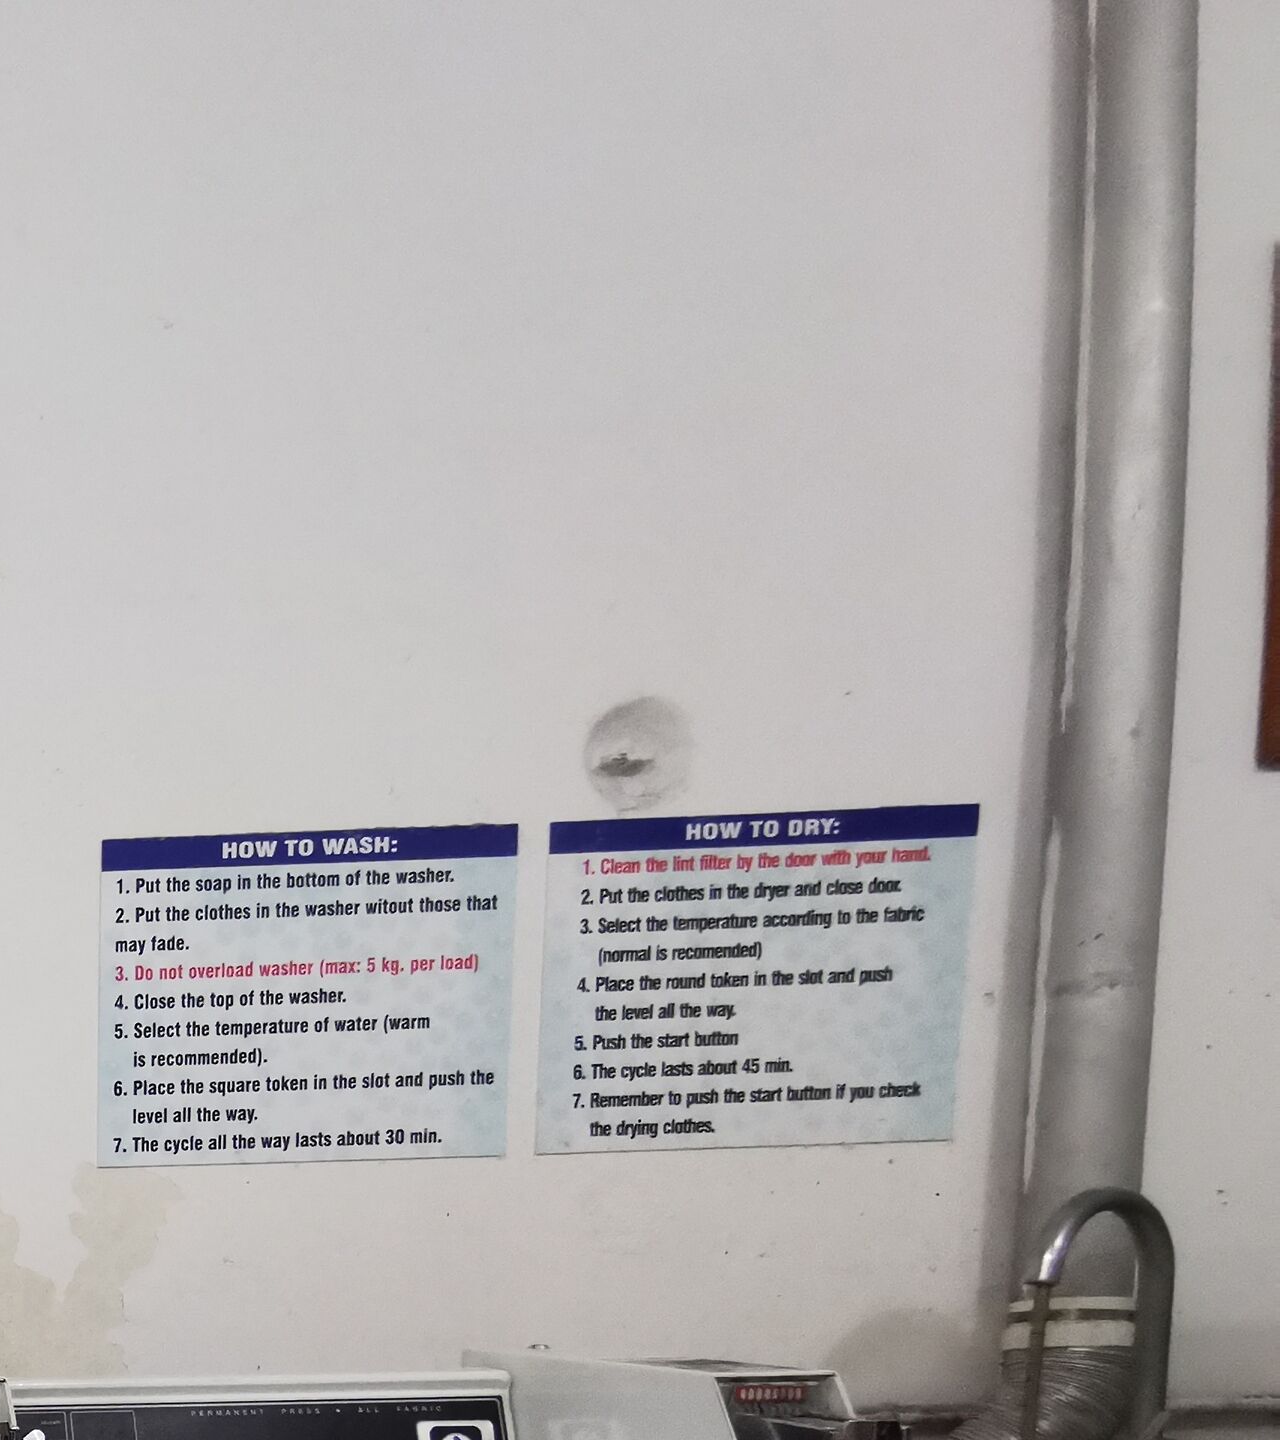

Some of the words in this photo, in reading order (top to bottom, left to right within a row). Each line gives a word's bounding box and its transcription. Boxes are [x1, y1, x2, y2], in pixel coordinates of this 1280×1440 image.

[686, 822, 742, 840] HOW
[751, 820, 778, 838] TO
[788, 818, 839, 836] DRY:
[222, 840, 277, 859] HOW
[284, 839, 314, 856] TO
[322, 836, 398, 855] WASH:
[583, 859, 595, 875] 1.
[600, 858, 641, 875] Clean
[645, 857, 668, 873] the
[672, 855, 695, 872] lint
[699, 854, 732, 871] filter
[736, 854, 754, 873] by
[758, 852, 780, 869] the
[785, 852, 817, 868] door
[821, 849, 852, 866] with
[856, 850, 888, 869] your
[891, 846, 931, 863] hand.
[116, 878, 130, 894] 1.
[136, 878, 161, 894] Put
[166, 876, 190, 893] the
[195, 878, 232, 895] soap
[237, 874, 251, 890] in
[256, 873, 281, 890] the
[286, 872, 340, 888] bottom
[345, 869, 361, 886] of
[365, 869, 390, 886] the
[396, 867, 454, 884] washer.
[598, 945, 652, 967] (normal
[656, 944, 668, 961] is
[672, 941, 762, 960] recomended)
[115, 966, 128, 982] 3.
[135, 965, 153, 981] Do
[159, 964, 183, 980] not
[188, 961, 254, 979] overload
[259, 960, 314, 977] washer
[320, 959, 361, 978] (max:
[366, 957, 376, 973] 5
[382, 957, 404, 976] kg.
[410, 959, 435, 975] per
[440, 954, 479, 973] load)
[573, 1064, 586, 1080] 6.
[591, 1063, 617, 1080] The
[620, 1062, 657, 1082] cycle
[660, 1061, 694, 1077] lasts
[697, 1059, 738, 1076] about
[741, 1058, 760, 1074] 45
[764, 1057, 793, 1073] min.
